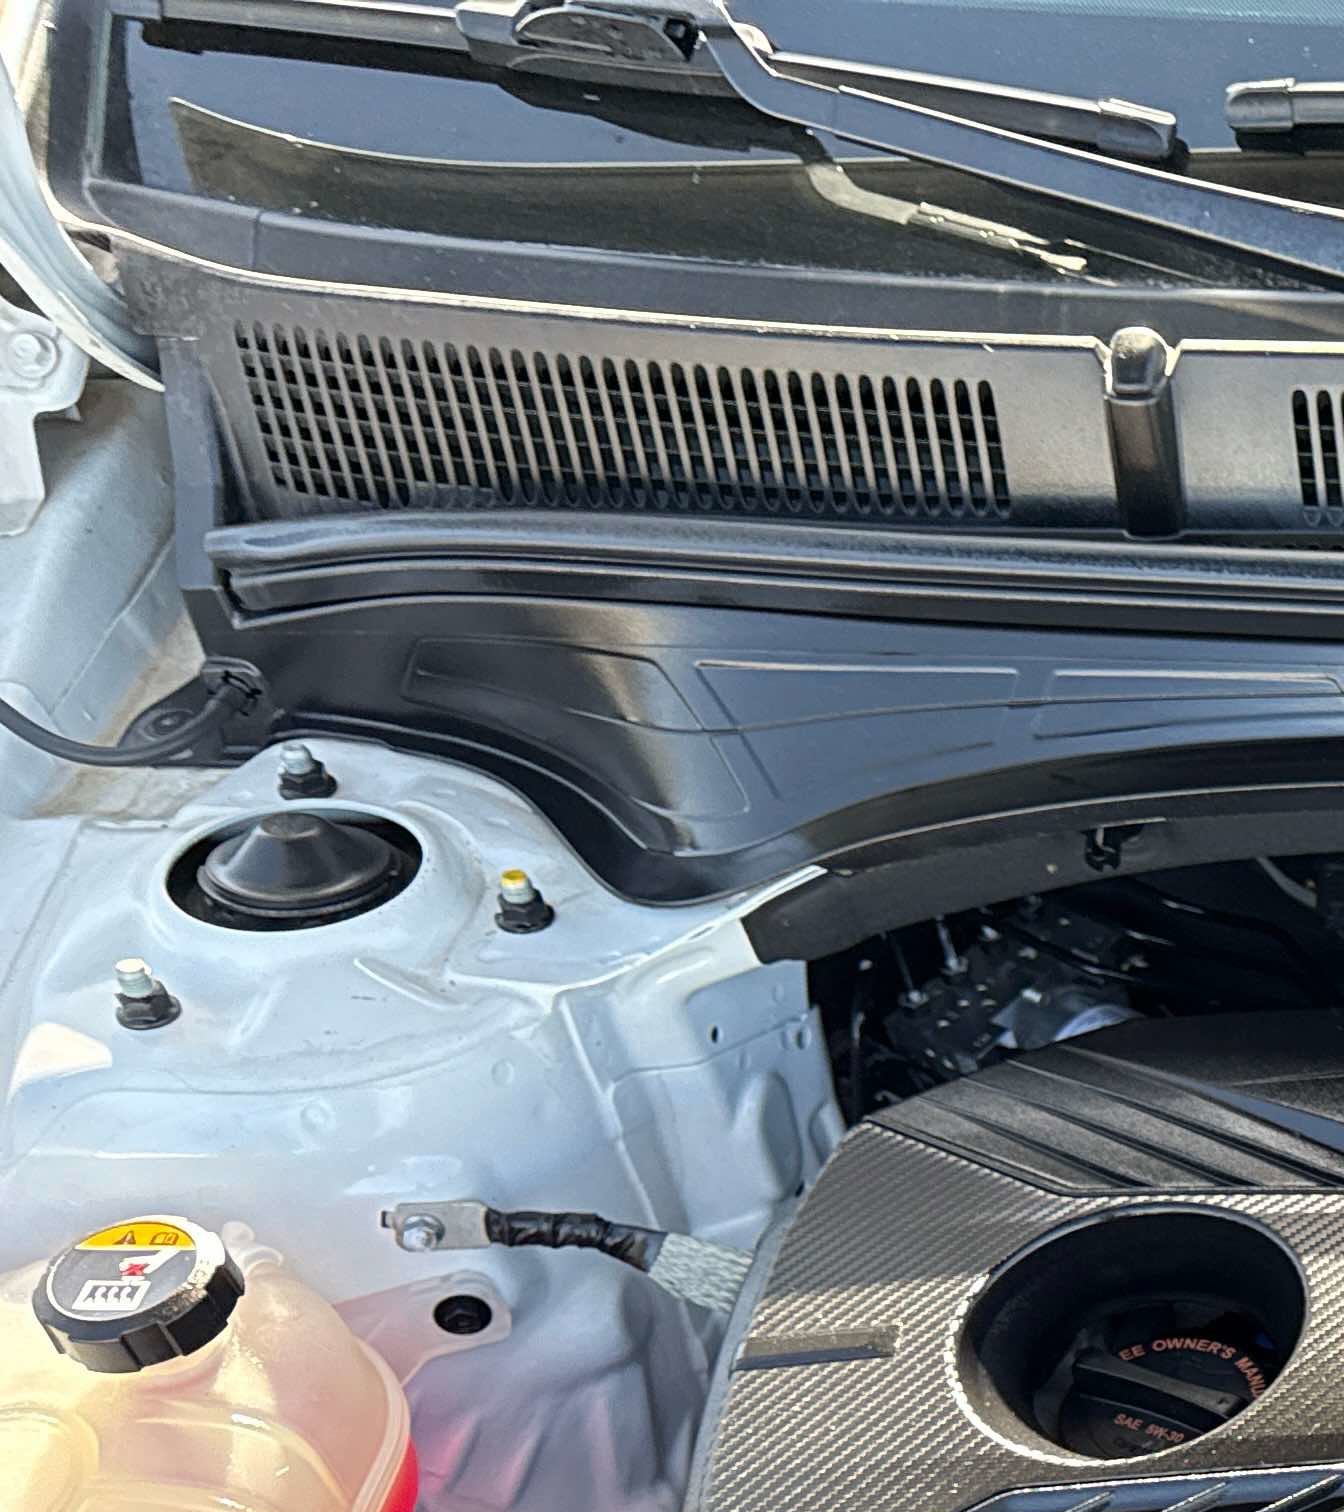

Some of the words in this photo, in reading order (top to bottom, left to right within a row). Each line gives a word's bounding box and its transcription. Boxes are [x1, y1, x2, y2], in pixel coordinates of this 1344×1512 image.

[1118, 1344, 1146, 1361] EE
[1151, 1338, 1237, 1360] OWNER'S
[1234, 1355, 1266, 1400] MANU
[1113, 1412, 1144, 1431] SAE
